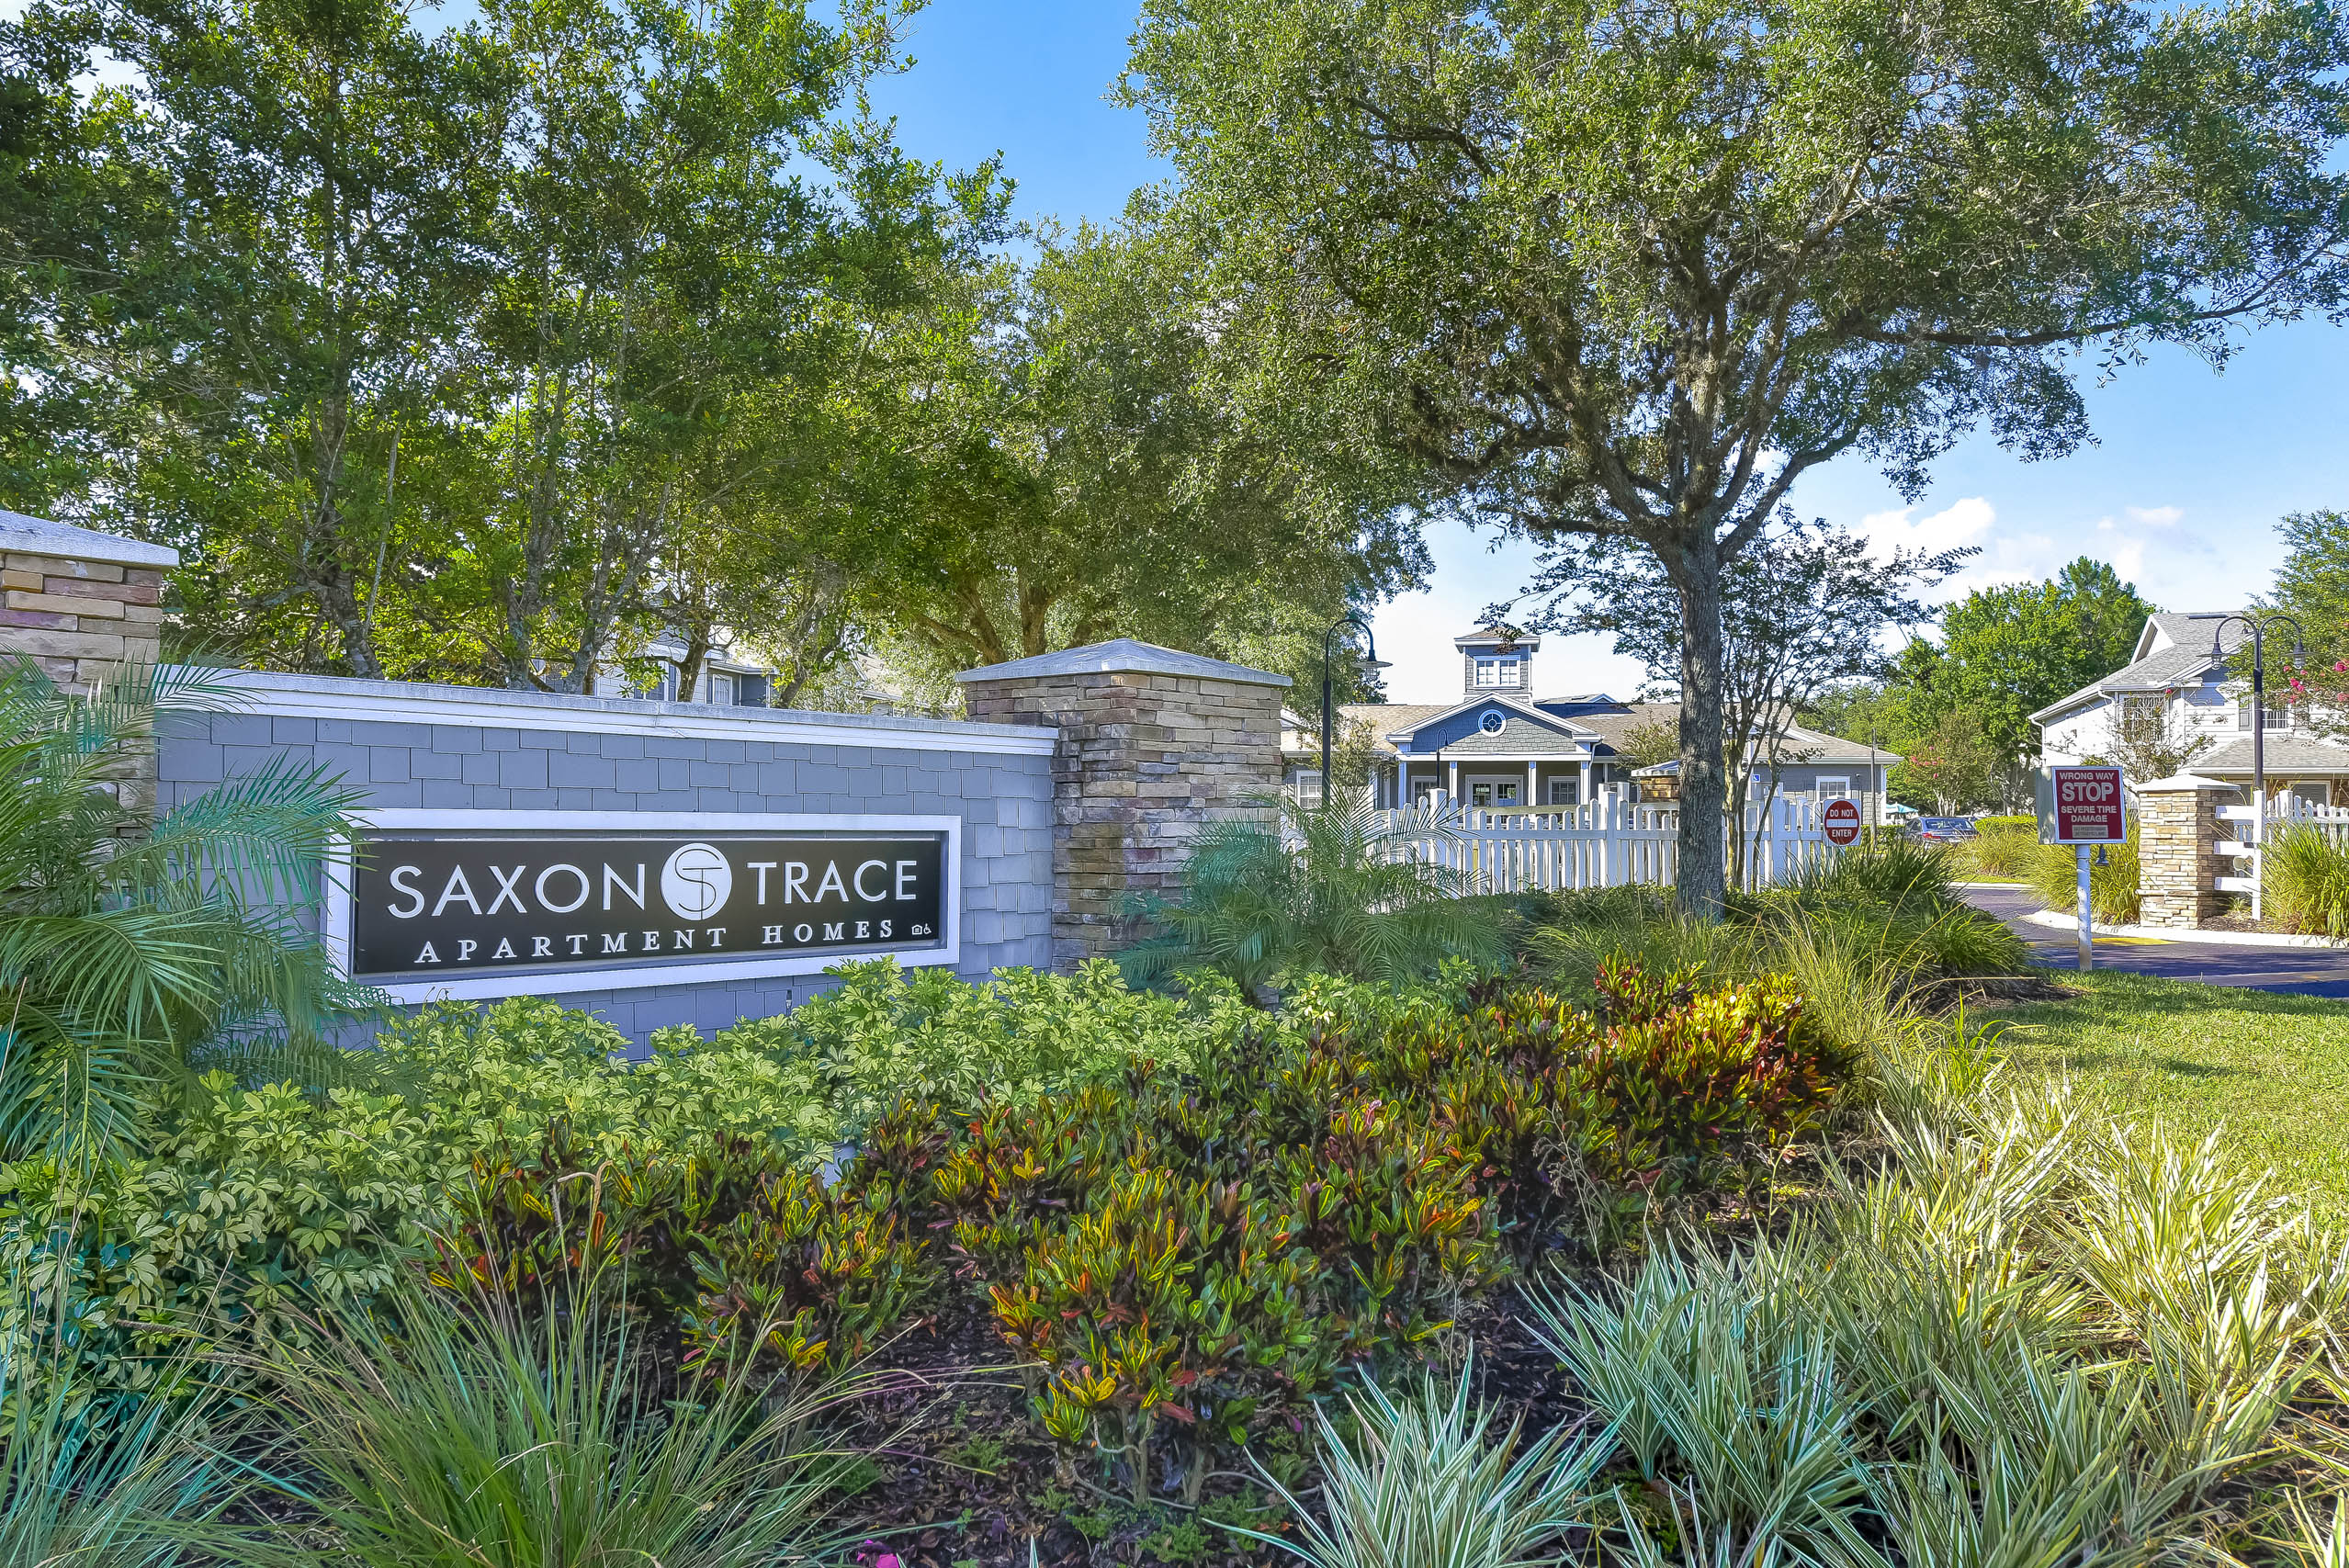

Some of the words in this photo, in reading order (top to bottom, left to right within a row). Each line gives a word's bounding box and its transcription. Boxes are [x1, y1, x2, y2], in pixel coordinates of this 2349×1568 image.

[2061, 782, 2114, 802] STOP
[1830, 809, 1839, 818] DO
[1841, 809, 1854, 818] NOT
[2061, 806, 2095, 814] SEVERE
[2096, 806, 2117, 814] TIRE
[2071, 815, 2107, 823] DAMAGE
[1832, 829, 1852, 838] ENTER
[387, 863, 646, 919] SAXON
[747, 859, 918, 907] TRACE
[413, 927, 728, 965] APARTMENT
[761, 919, 895, 945] HOMES
